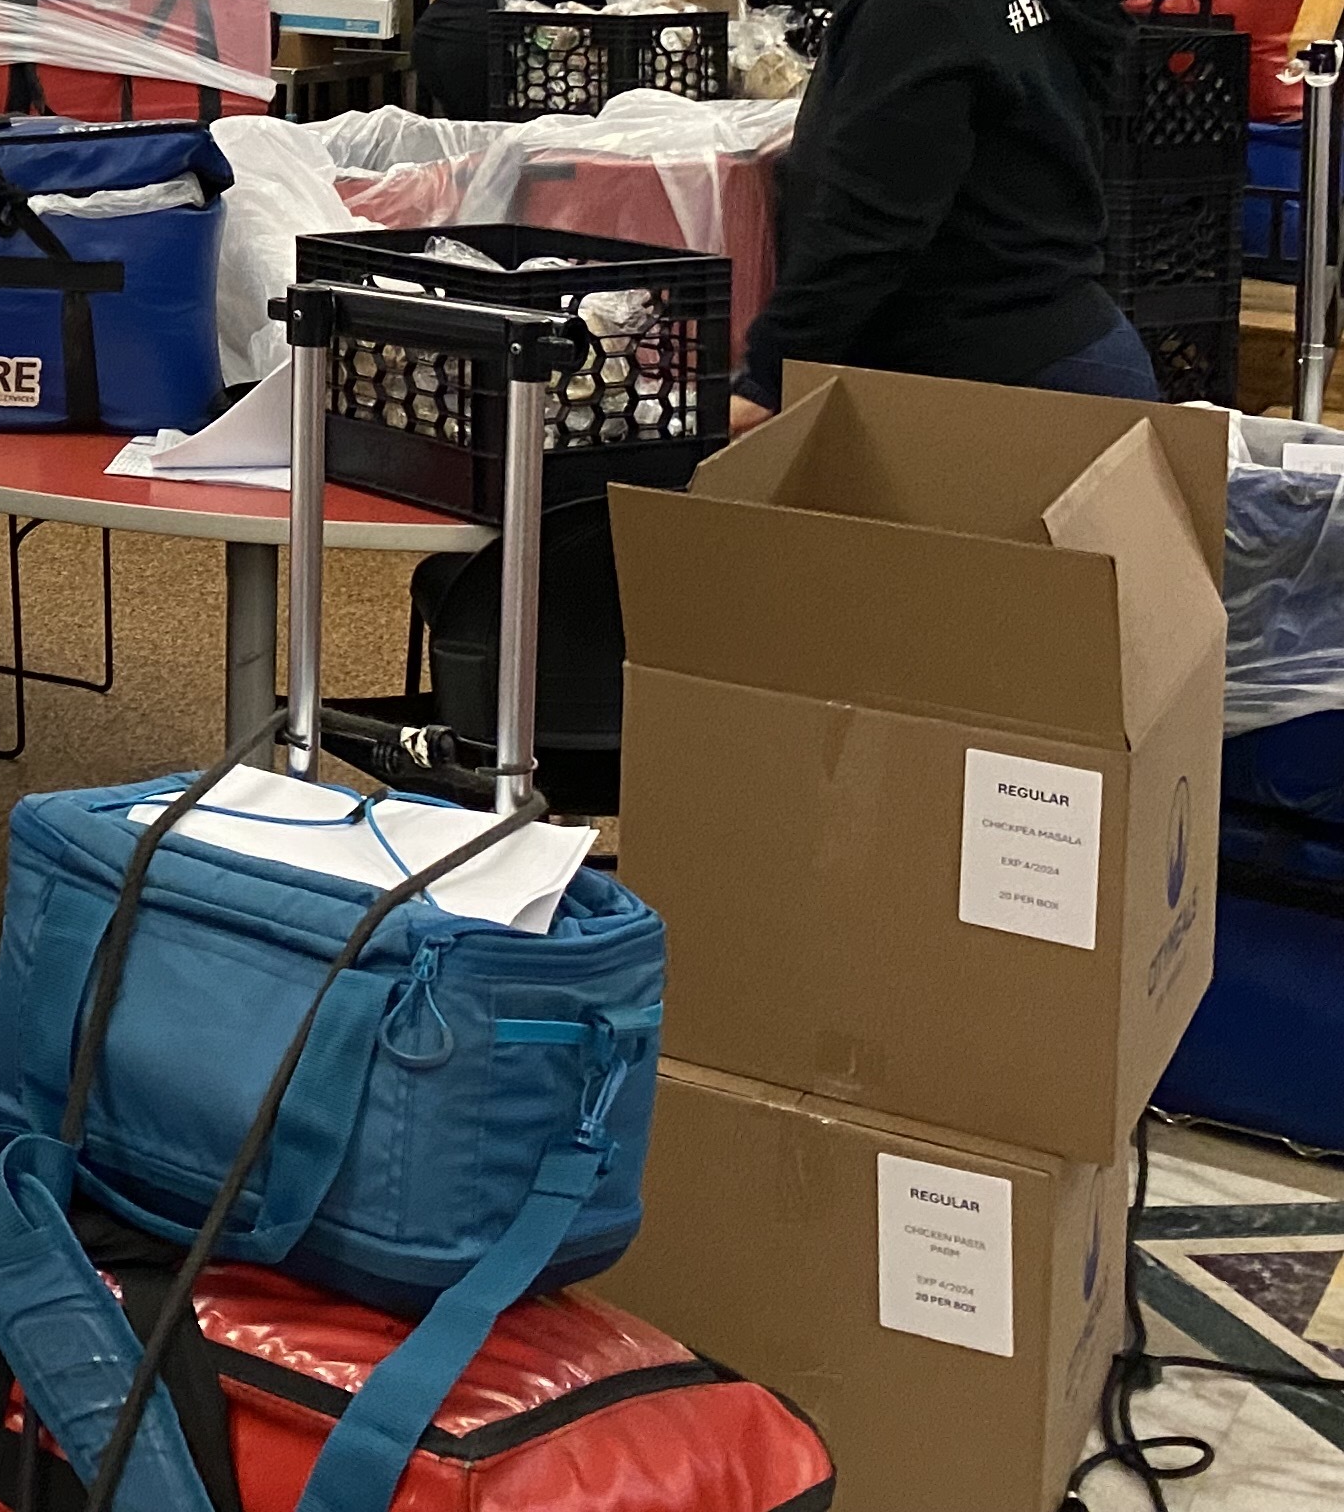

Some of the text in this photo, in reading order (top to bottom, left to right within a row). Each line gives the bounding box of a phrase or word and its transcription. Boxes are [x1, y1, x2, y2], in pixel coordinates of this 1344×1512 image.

[998, 782, 1070, 807] REGULAR
[981, 818, 1082, 846] CHICKPEA MASALA
[1000, 856, 1022, 868] EXP
[998, 890, 1059, 911] 20 PER BOX
[910, 1187, 980, 1213] REGULAR
[904, 1224, 986, 1252] CHICKEN PASTA
[916, 1274, 937, 1287] EXP
[915, 1292, 977, 1314] 20 PER BOX
